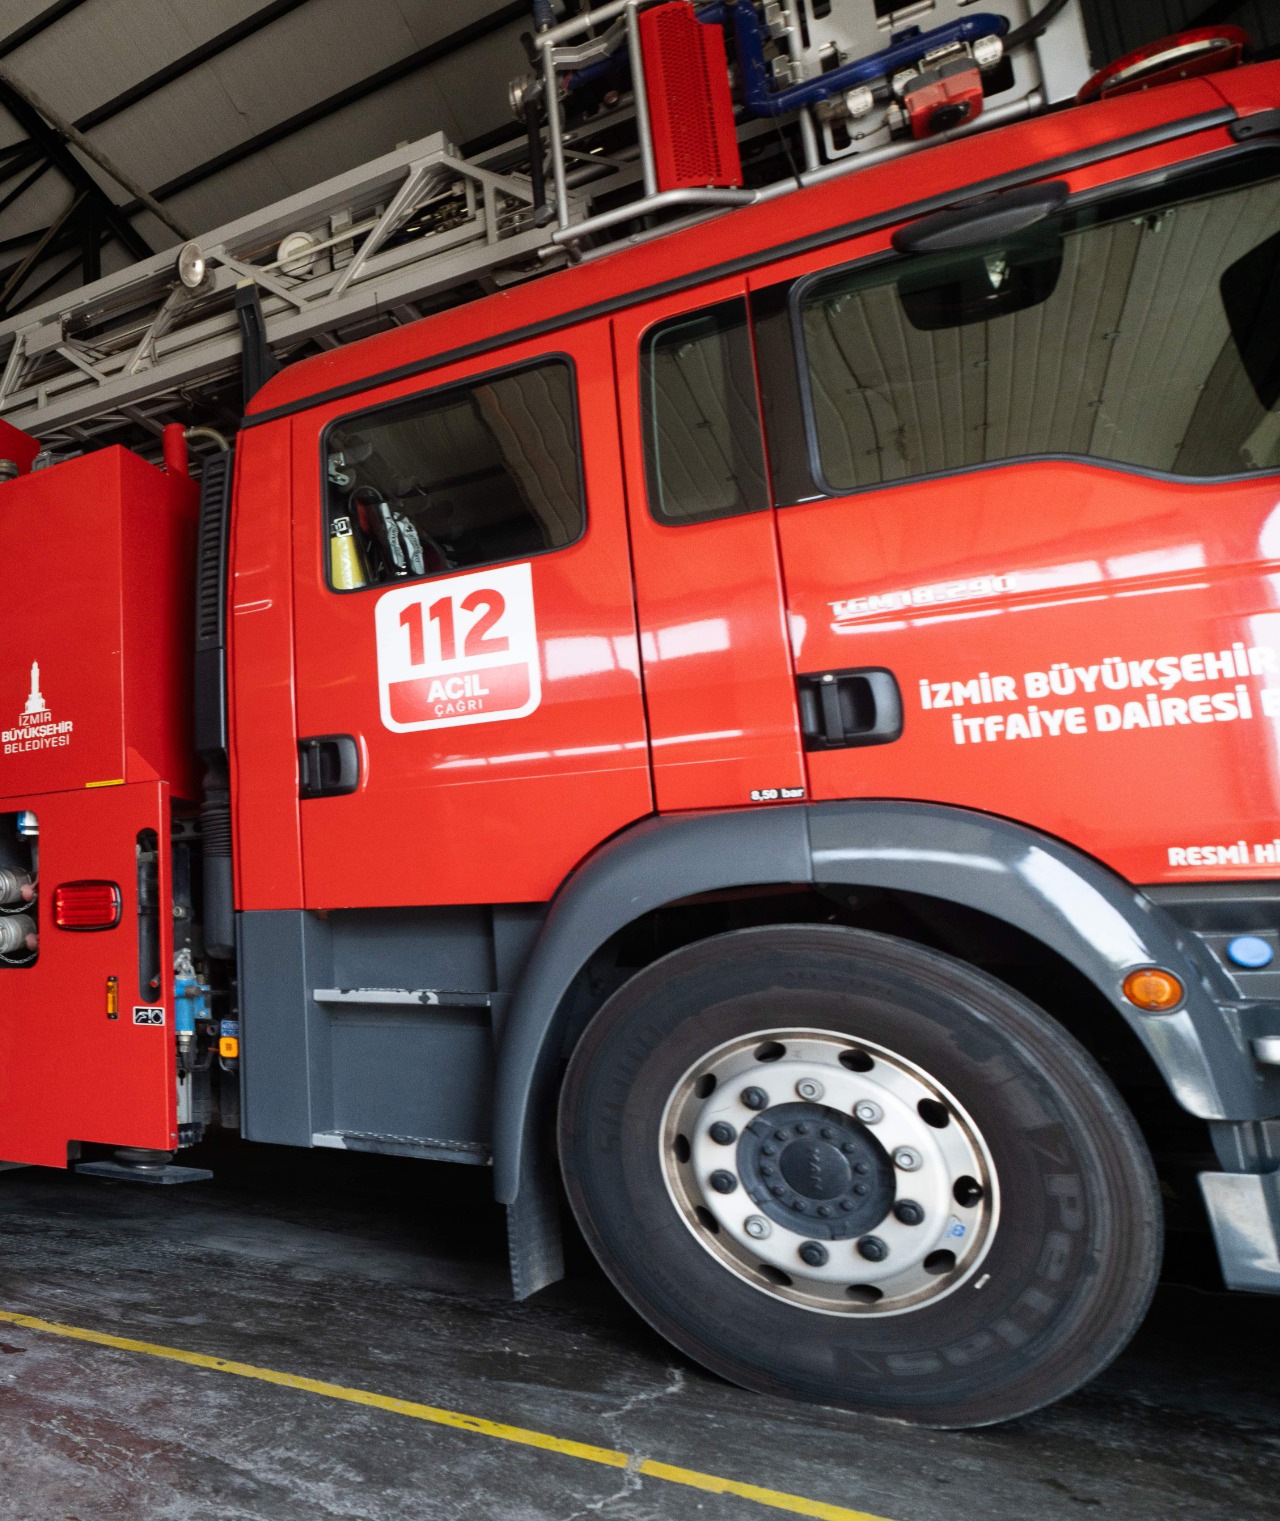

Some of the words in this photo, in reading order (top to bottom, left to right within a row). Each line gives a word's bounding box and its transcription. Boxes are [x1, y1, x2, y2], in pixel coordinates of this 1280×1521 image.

[399, 588, 510, 666] 112
[919, 672, 1019, 710] İZMİR
[1024, 642, 1278, 699] BÜYÜKŞEHİR
[426, 674, 490, 703] ACİL
[18, 712, 52, 727] İZMİR
[434, 698, 483, 718] ÇAĞRI
[952, 705, 1088, 745] İTFAİYE
[1094, 684, 1253, 732] DAİRESİ
[1, 721, 73, 742] BÜYÜKŞEHİR
[4, 734, 70, 754] BELEDİYESİ
[781, 788, 804, 798] bar
[1168, 840, 1249, 866] RESMİ
